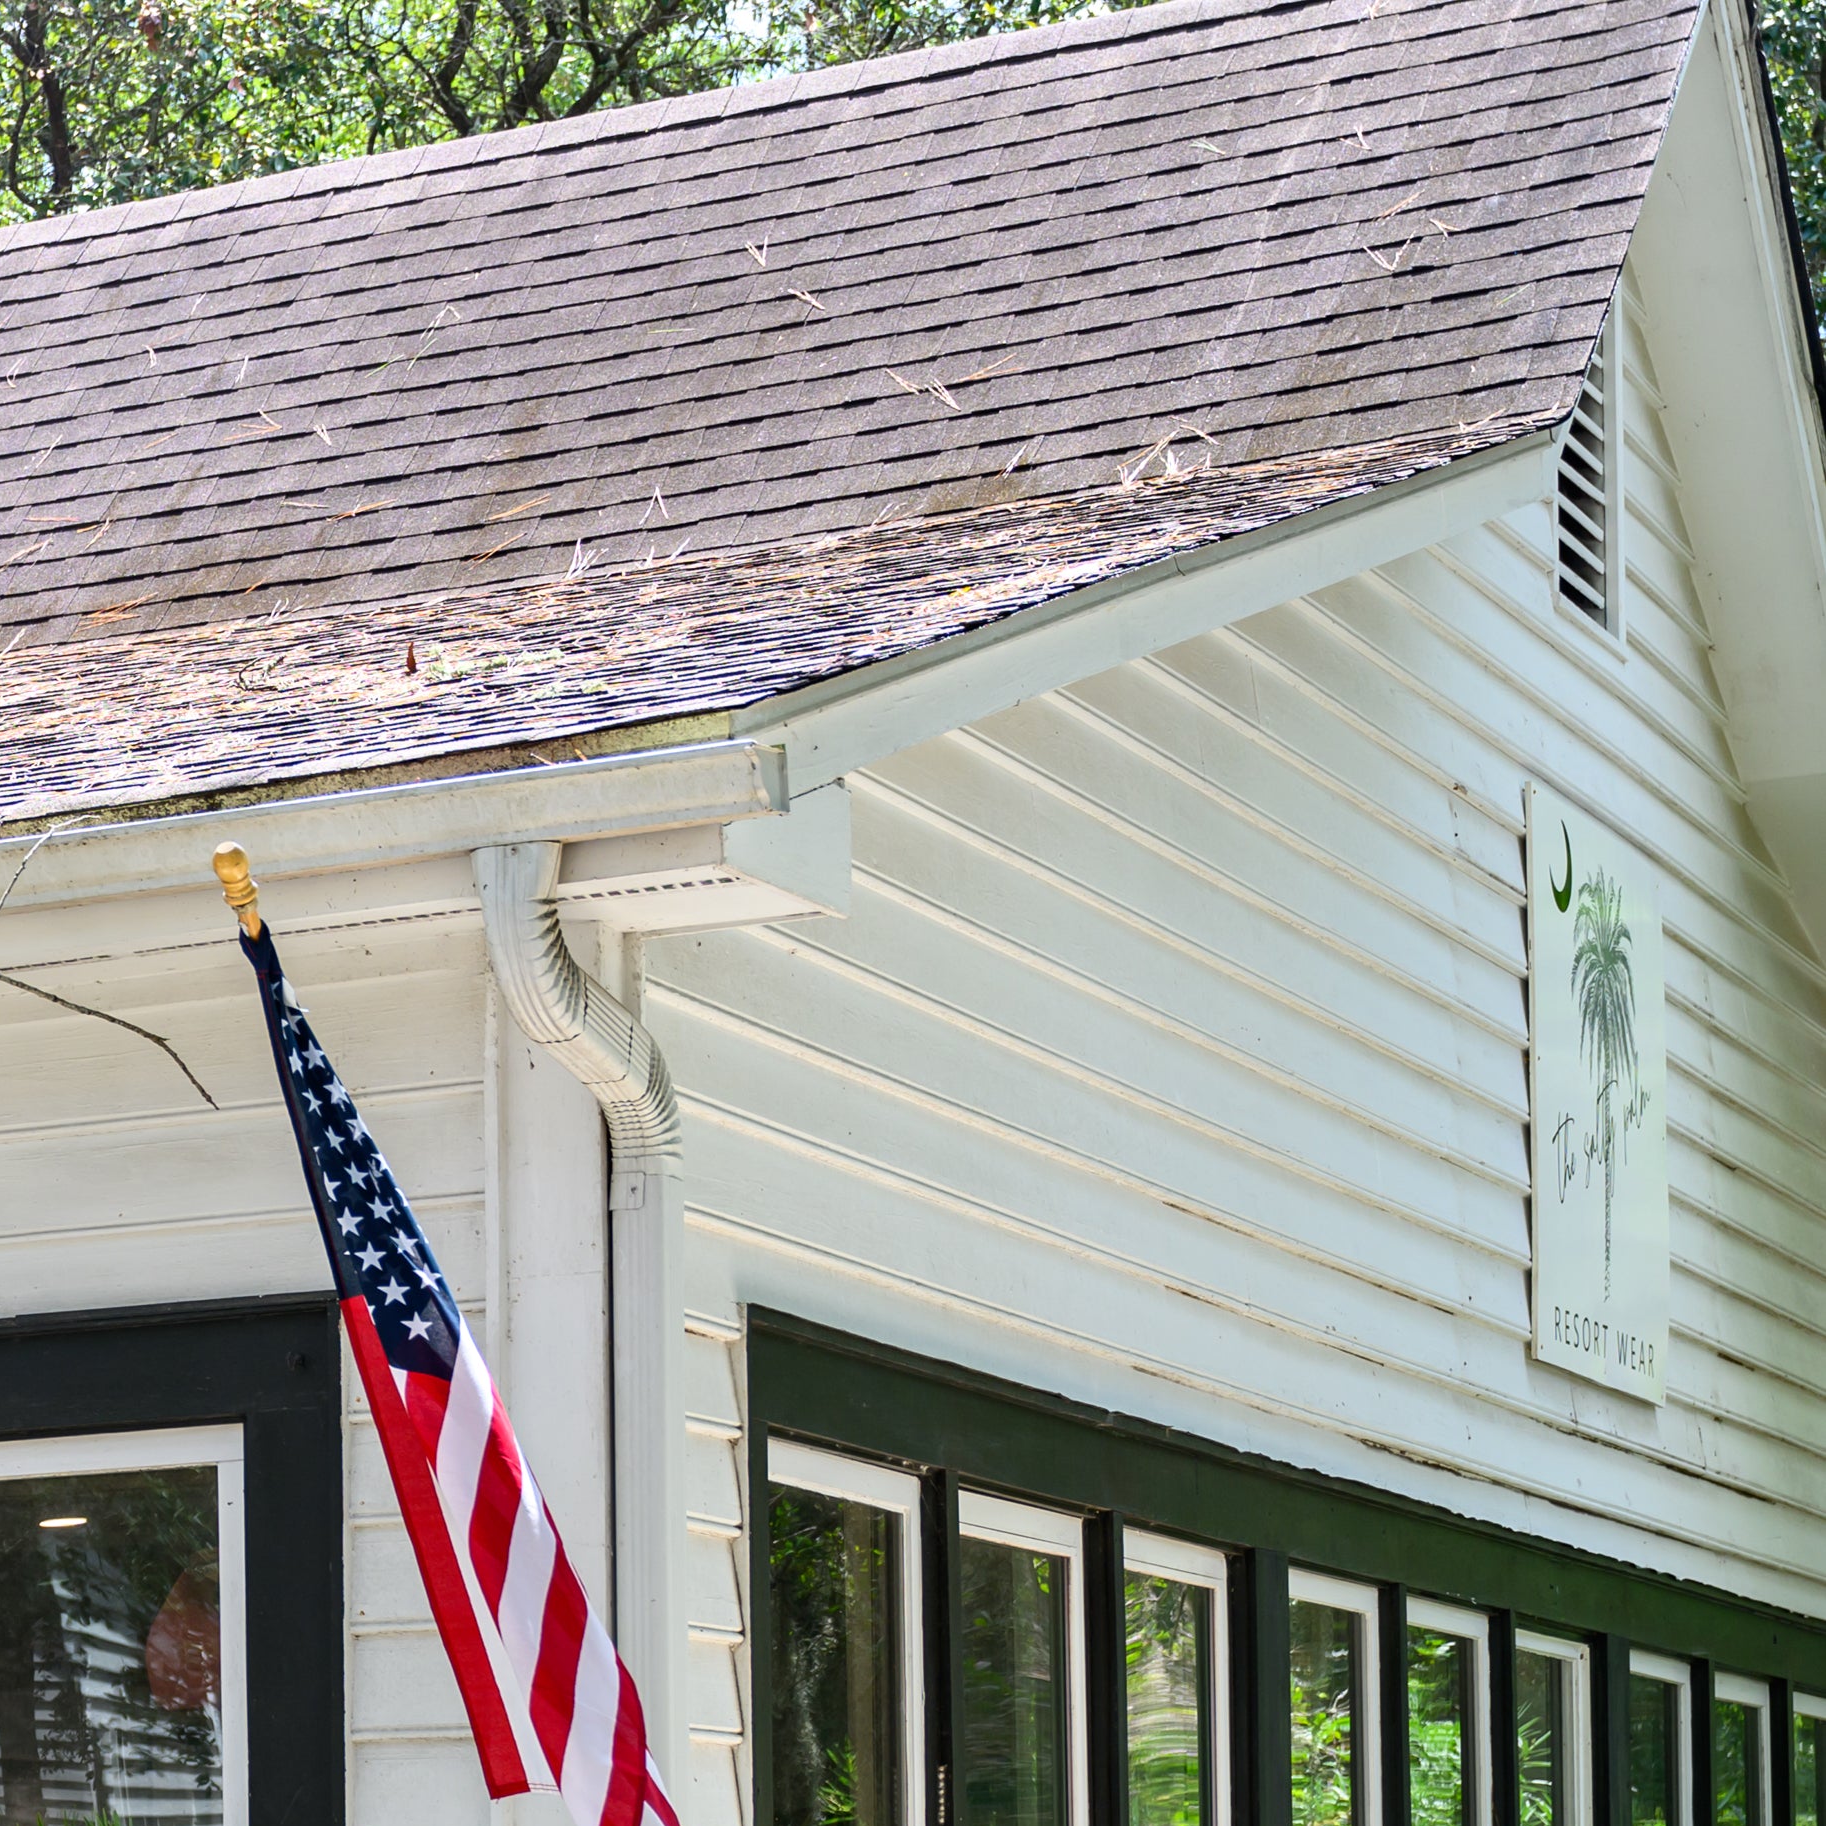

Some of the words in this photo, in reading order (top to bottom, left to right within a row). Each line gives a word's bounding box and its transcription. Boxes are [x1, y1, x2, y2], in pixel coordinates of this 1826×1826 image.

[1552, 1111, 1575, 1204] the
[1623, 1050, 1651, 1167] palm
[1554, 1306, 1609, 1359] RESORT
[1616, 1330, 1655, 1378] WEAR
